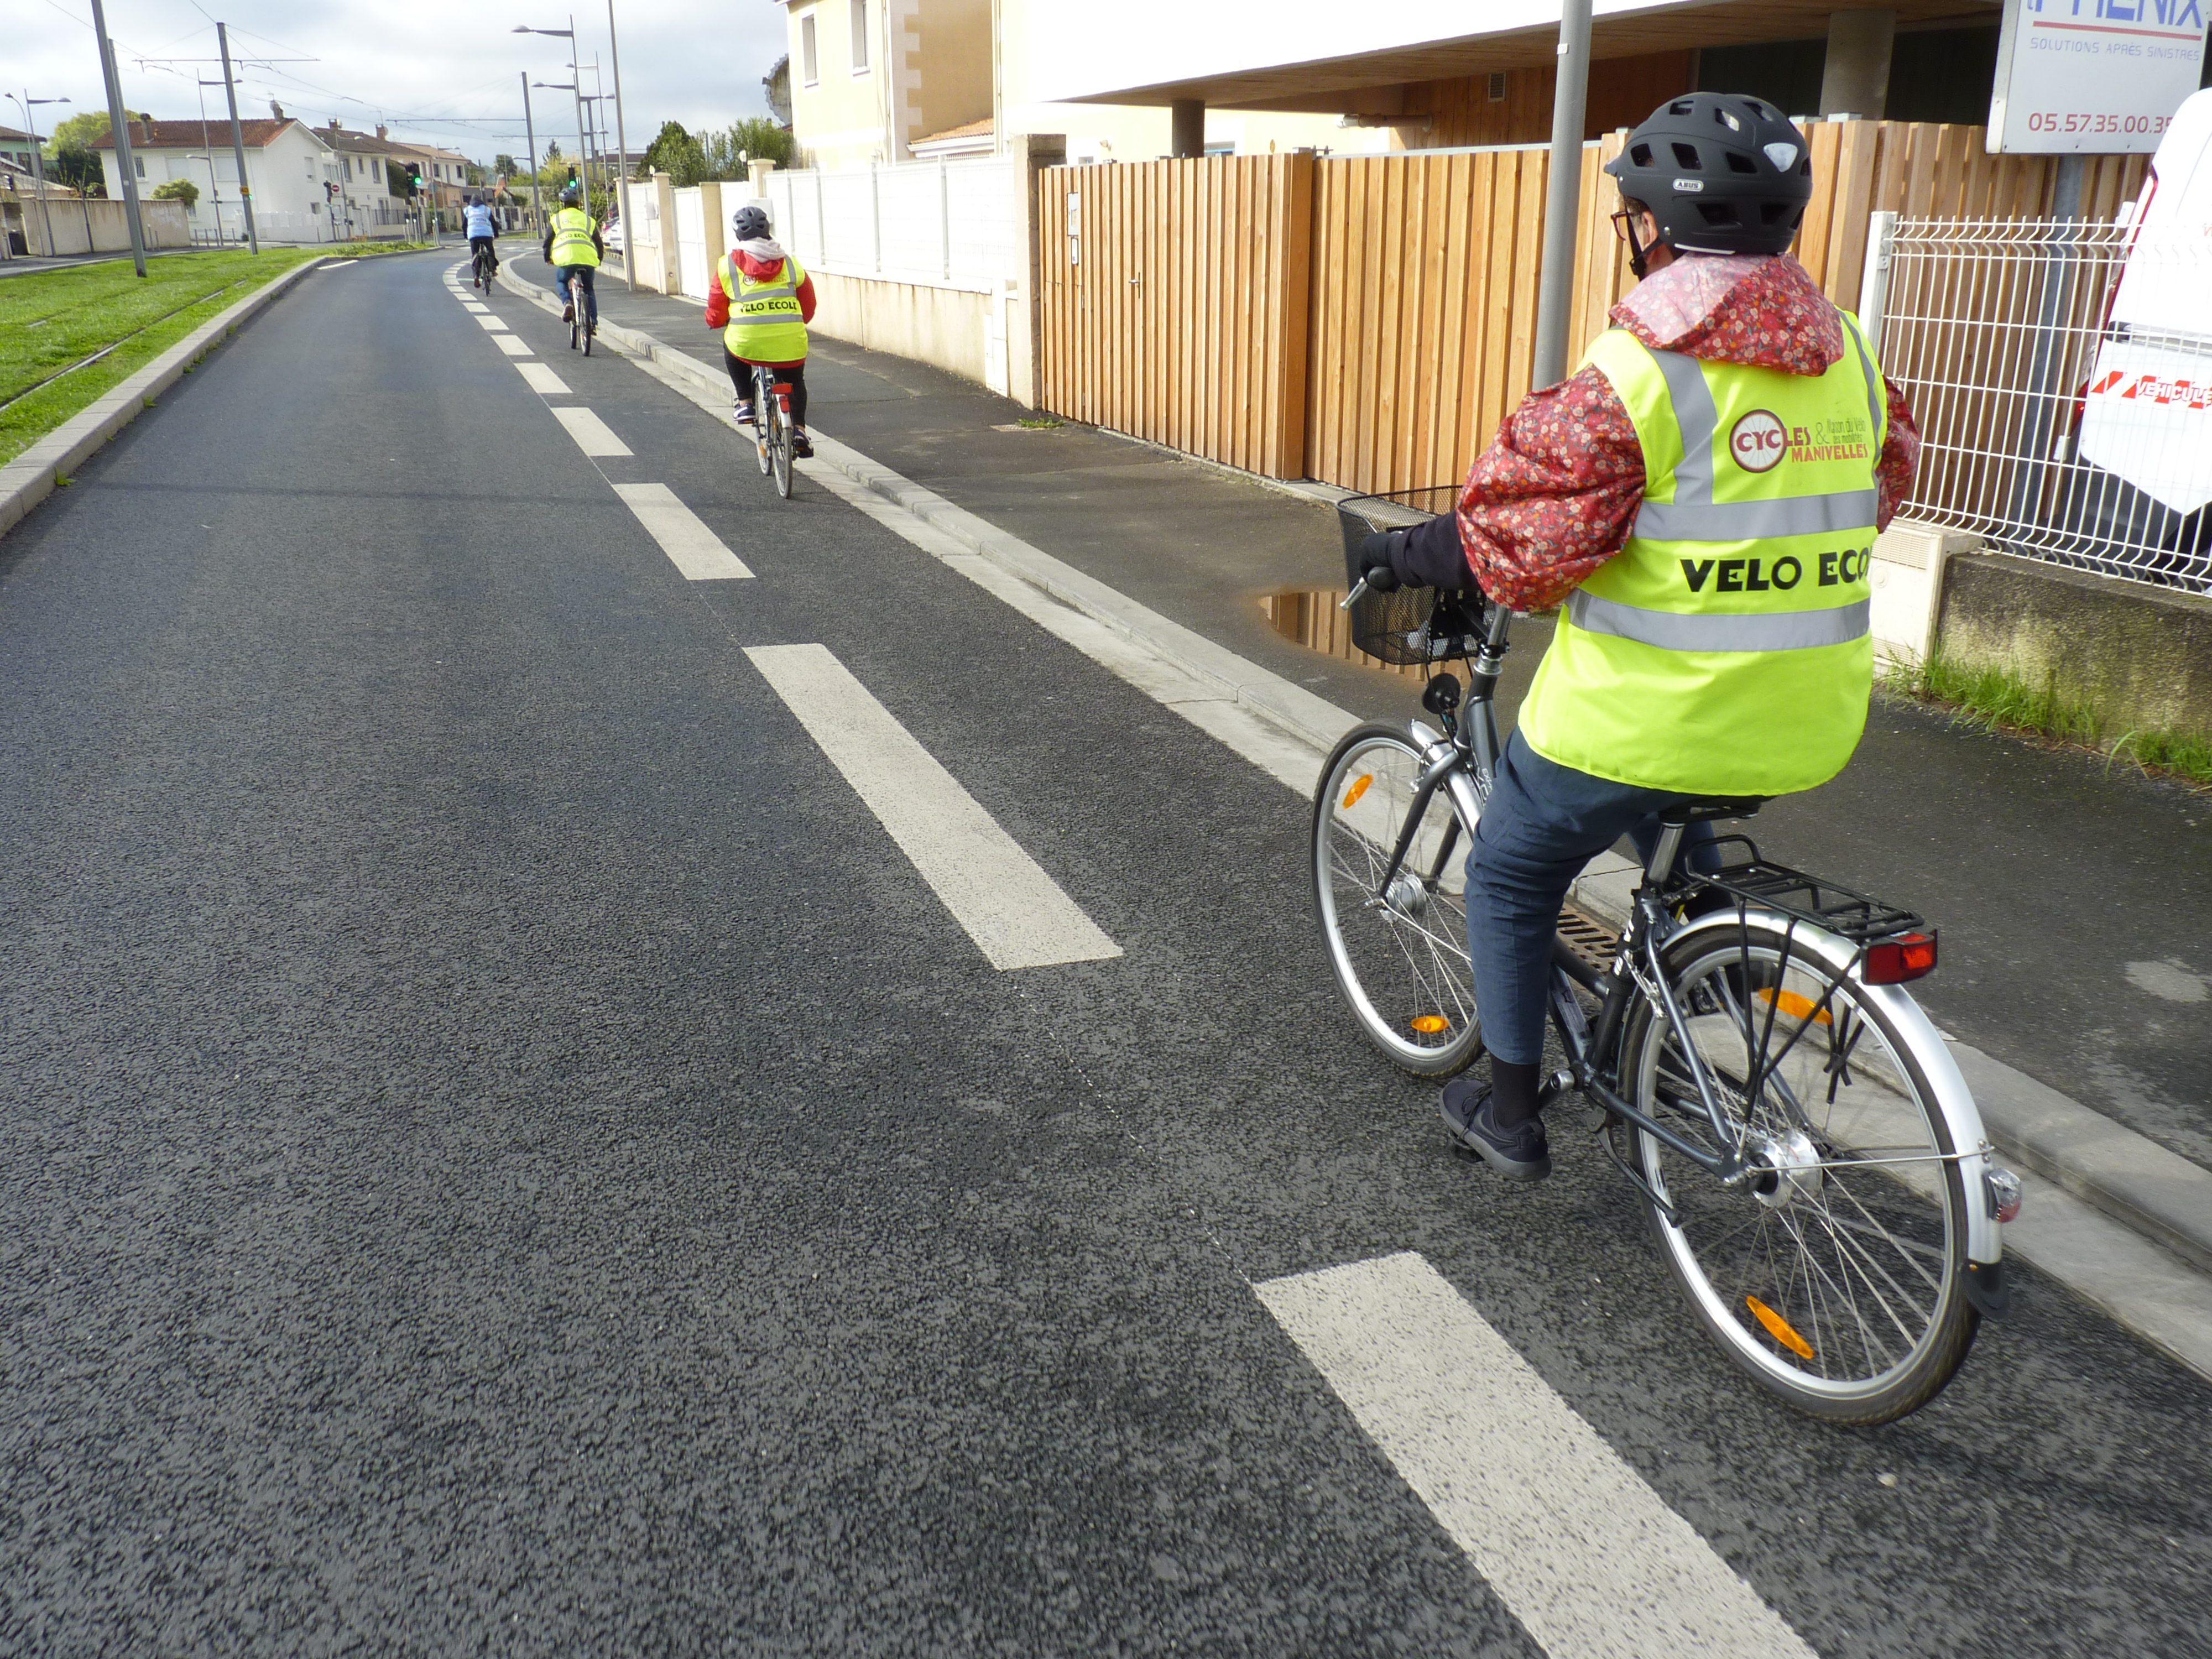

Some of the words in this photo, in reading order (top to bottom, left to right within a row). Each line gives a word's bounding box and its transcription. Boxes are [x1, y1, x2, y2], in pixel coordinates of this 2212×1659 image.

[2030, 37, 2100, 53] SOLUTIONS
[2147, 46, 2200, 61] SINISTRES
[1736, 426, 1812, 452] CYCLES
[1791, 444, 1869, 463] MANIVELLES
[1679, 556, 1802, 593] VELO
